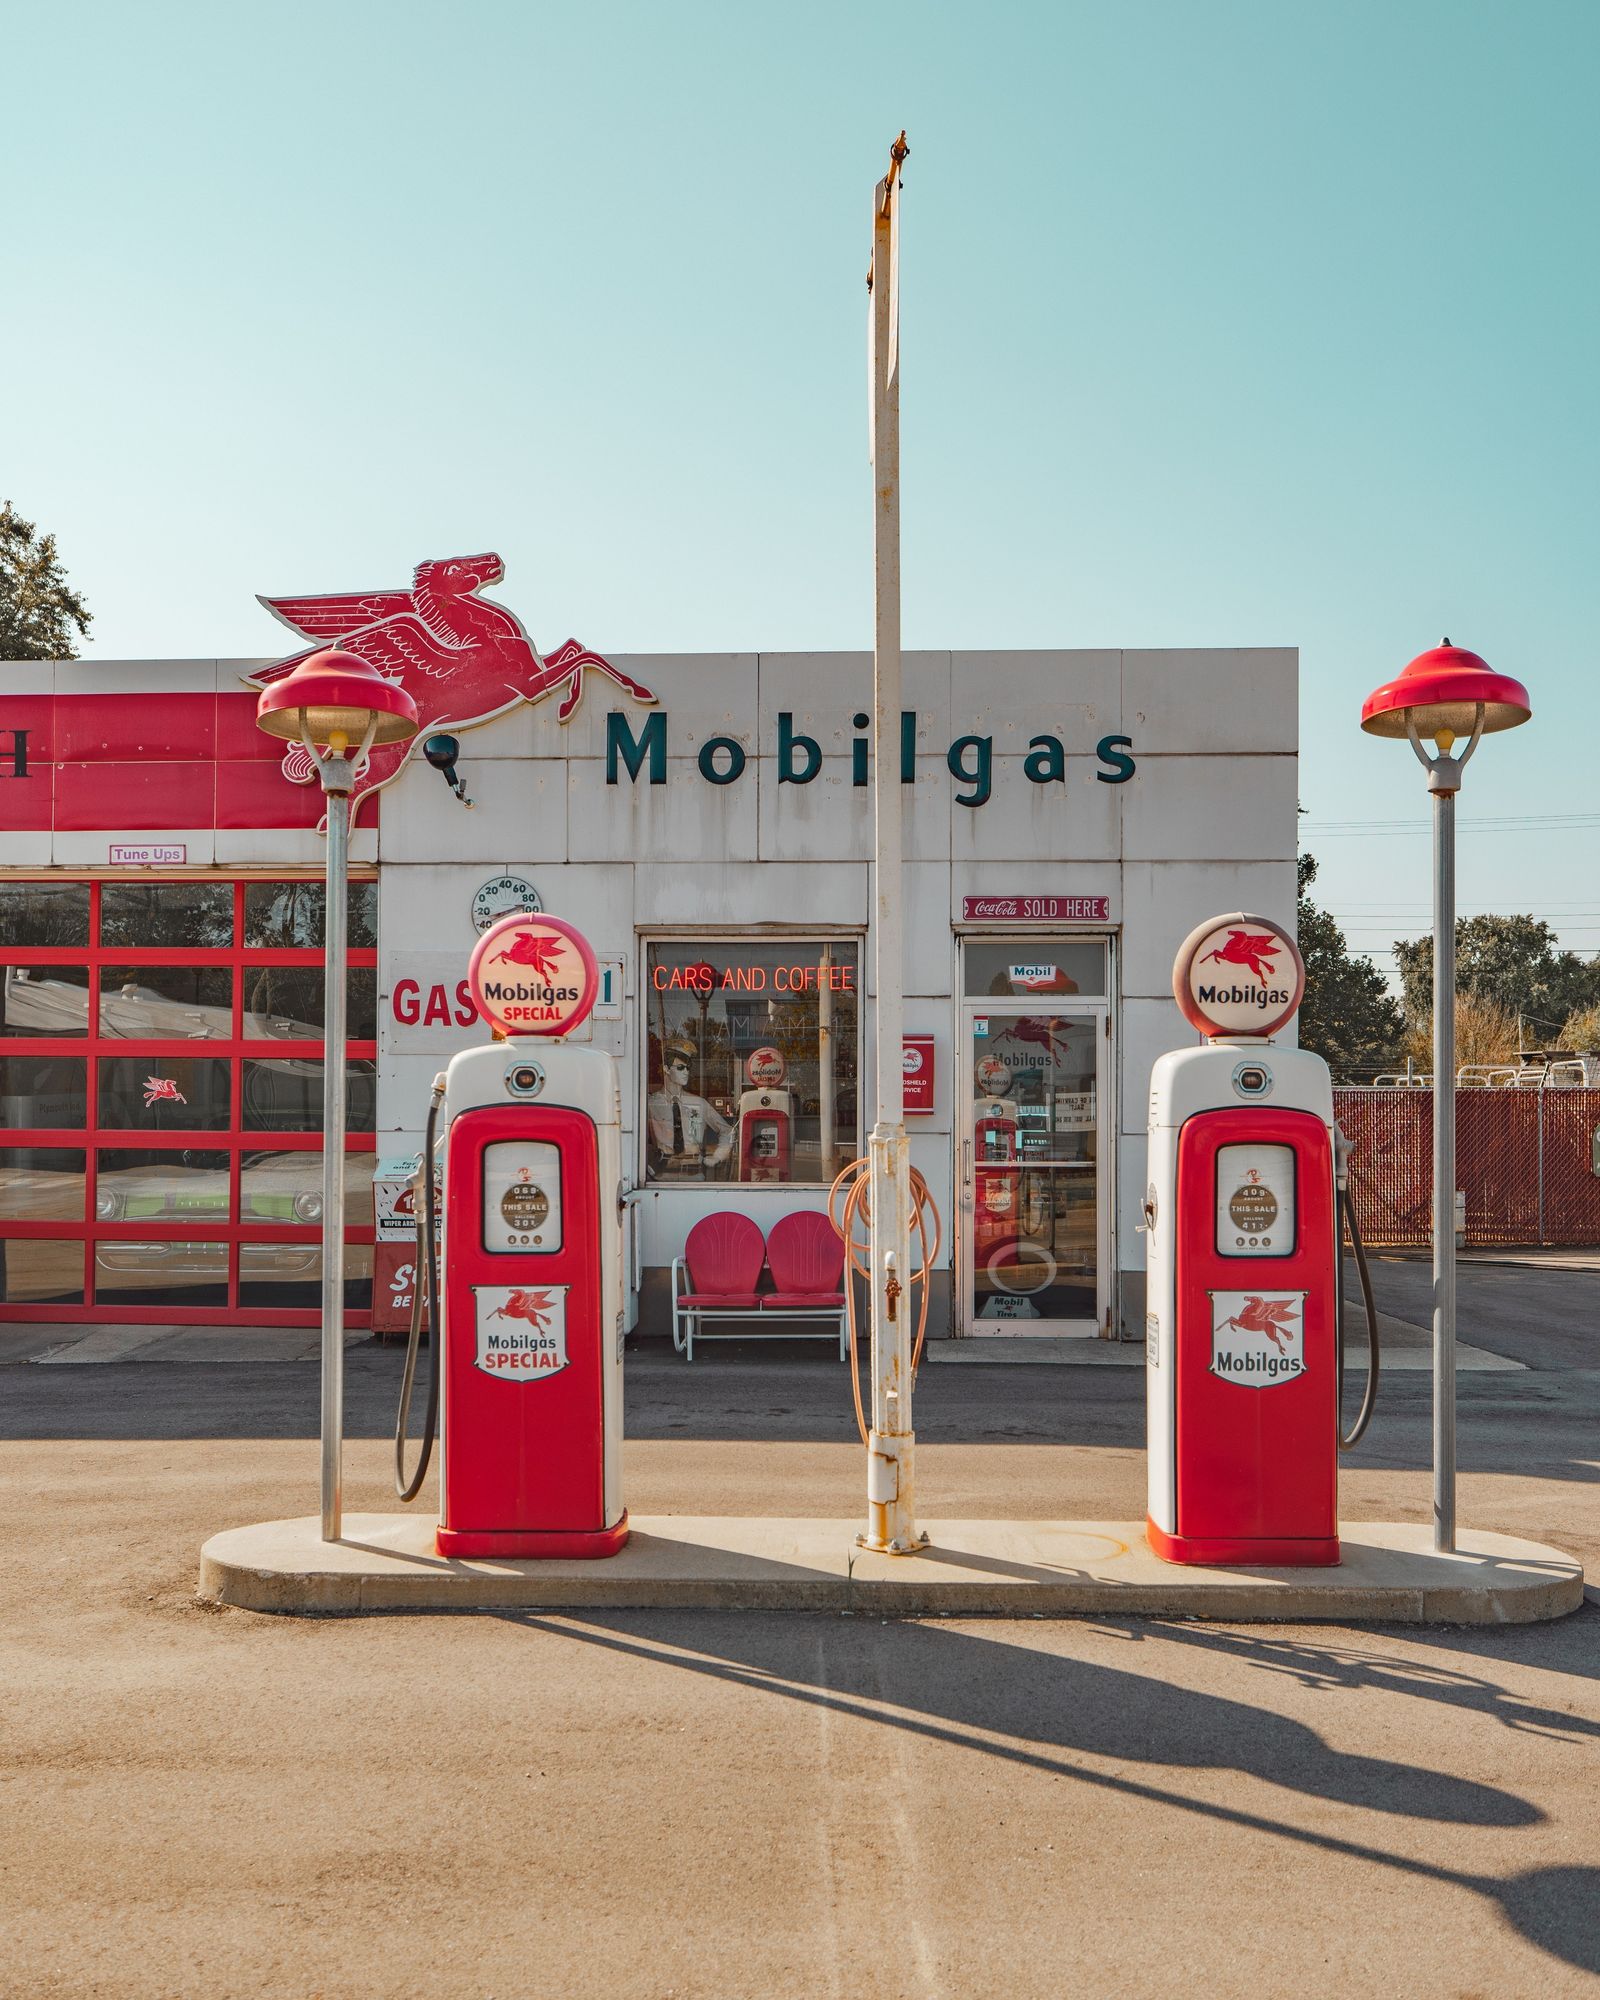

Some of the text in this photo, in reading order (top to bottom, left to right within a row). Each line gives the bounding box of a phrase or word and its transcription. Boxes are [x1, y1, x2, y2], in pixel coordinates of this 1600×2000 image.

[606, 711, 1137, 808] Mobilgas
[114, 848, 181, 863] Tune Ups
[486, 886, 498, 895] 20
[499, 880, 512, 888] 40
[513, 884, 526, 893] 60
[479, 894, 486, 902] 0
[522, 894, 535, 902] 80
[474, 907, 490, 916] -20
[974, 900, 1099, 917] Coca-Cola SOLD HERE
[476, 920, 492, 929] -40
[653, 965, 855, 992] CARS AND COFFEE
[1014, 966, 1051, 976] Mobil
[602, 969, 612, 1003] 1
[485, 982, 579, 1007] Mobilgas
[1198, 984, 1289, 1010] Mobilgas
[392, 978, 480, 1028] GAS
[503, 1006, 563, 1021] SPECIAL
[993, 1052, 1052, 1070] Mobilgas
[392, 1294, 412, 1308] BE
[994, 1297, 1024, 1306] Mobil
[488, 1335, 556, 1352] Mobilgas
[485, 1352, 561, 1369] SPECIAL
[1217, 1351, 1301, 1377] Mobilgas
